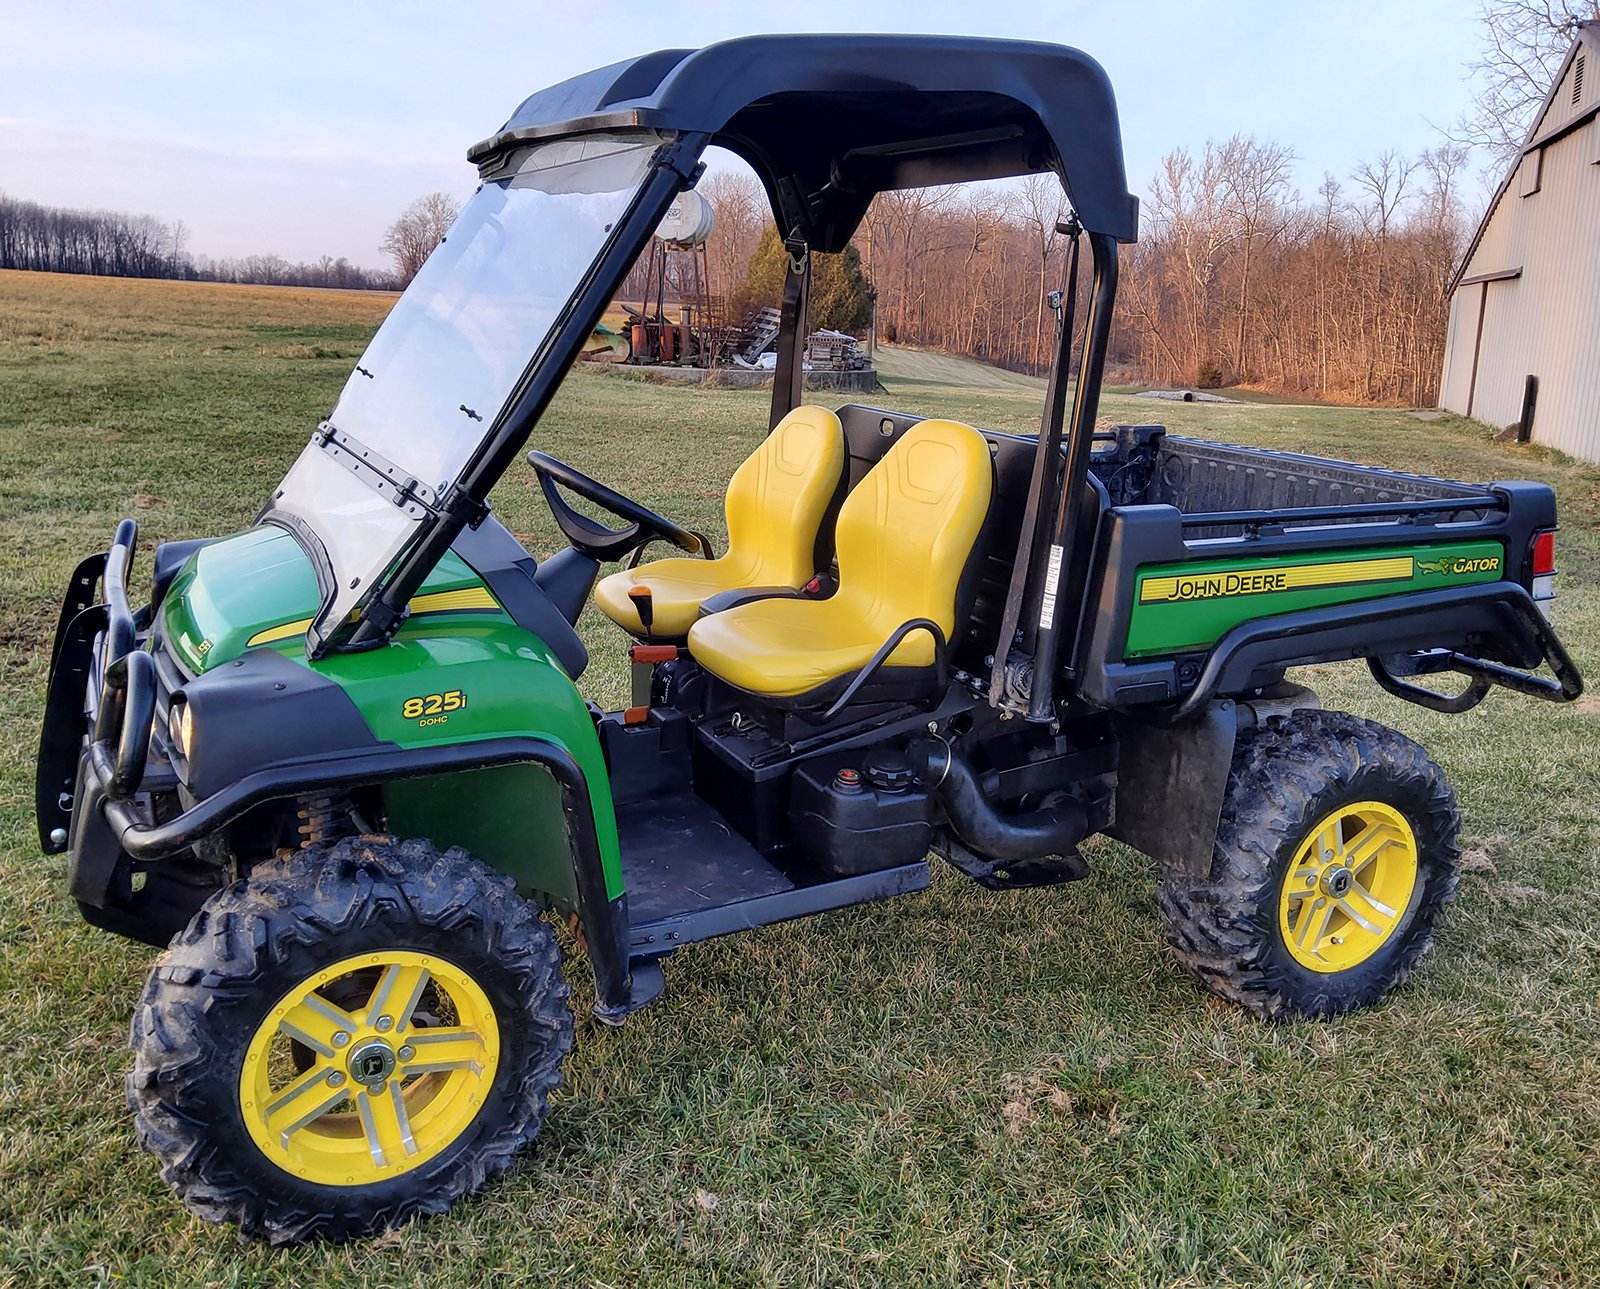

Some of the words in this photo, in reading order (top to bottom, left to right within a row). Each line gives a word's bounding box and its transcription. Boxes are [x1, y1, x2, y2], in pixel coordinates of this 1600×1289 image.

[1453, 557, 1500, 574] GATOR
[1168, 579, 1221, 599] JOHN
[1225, 573, 1287, 594] DEERE
[402, 690, 467, 718] 825i
[419, 715, 448, 727] DOHC
